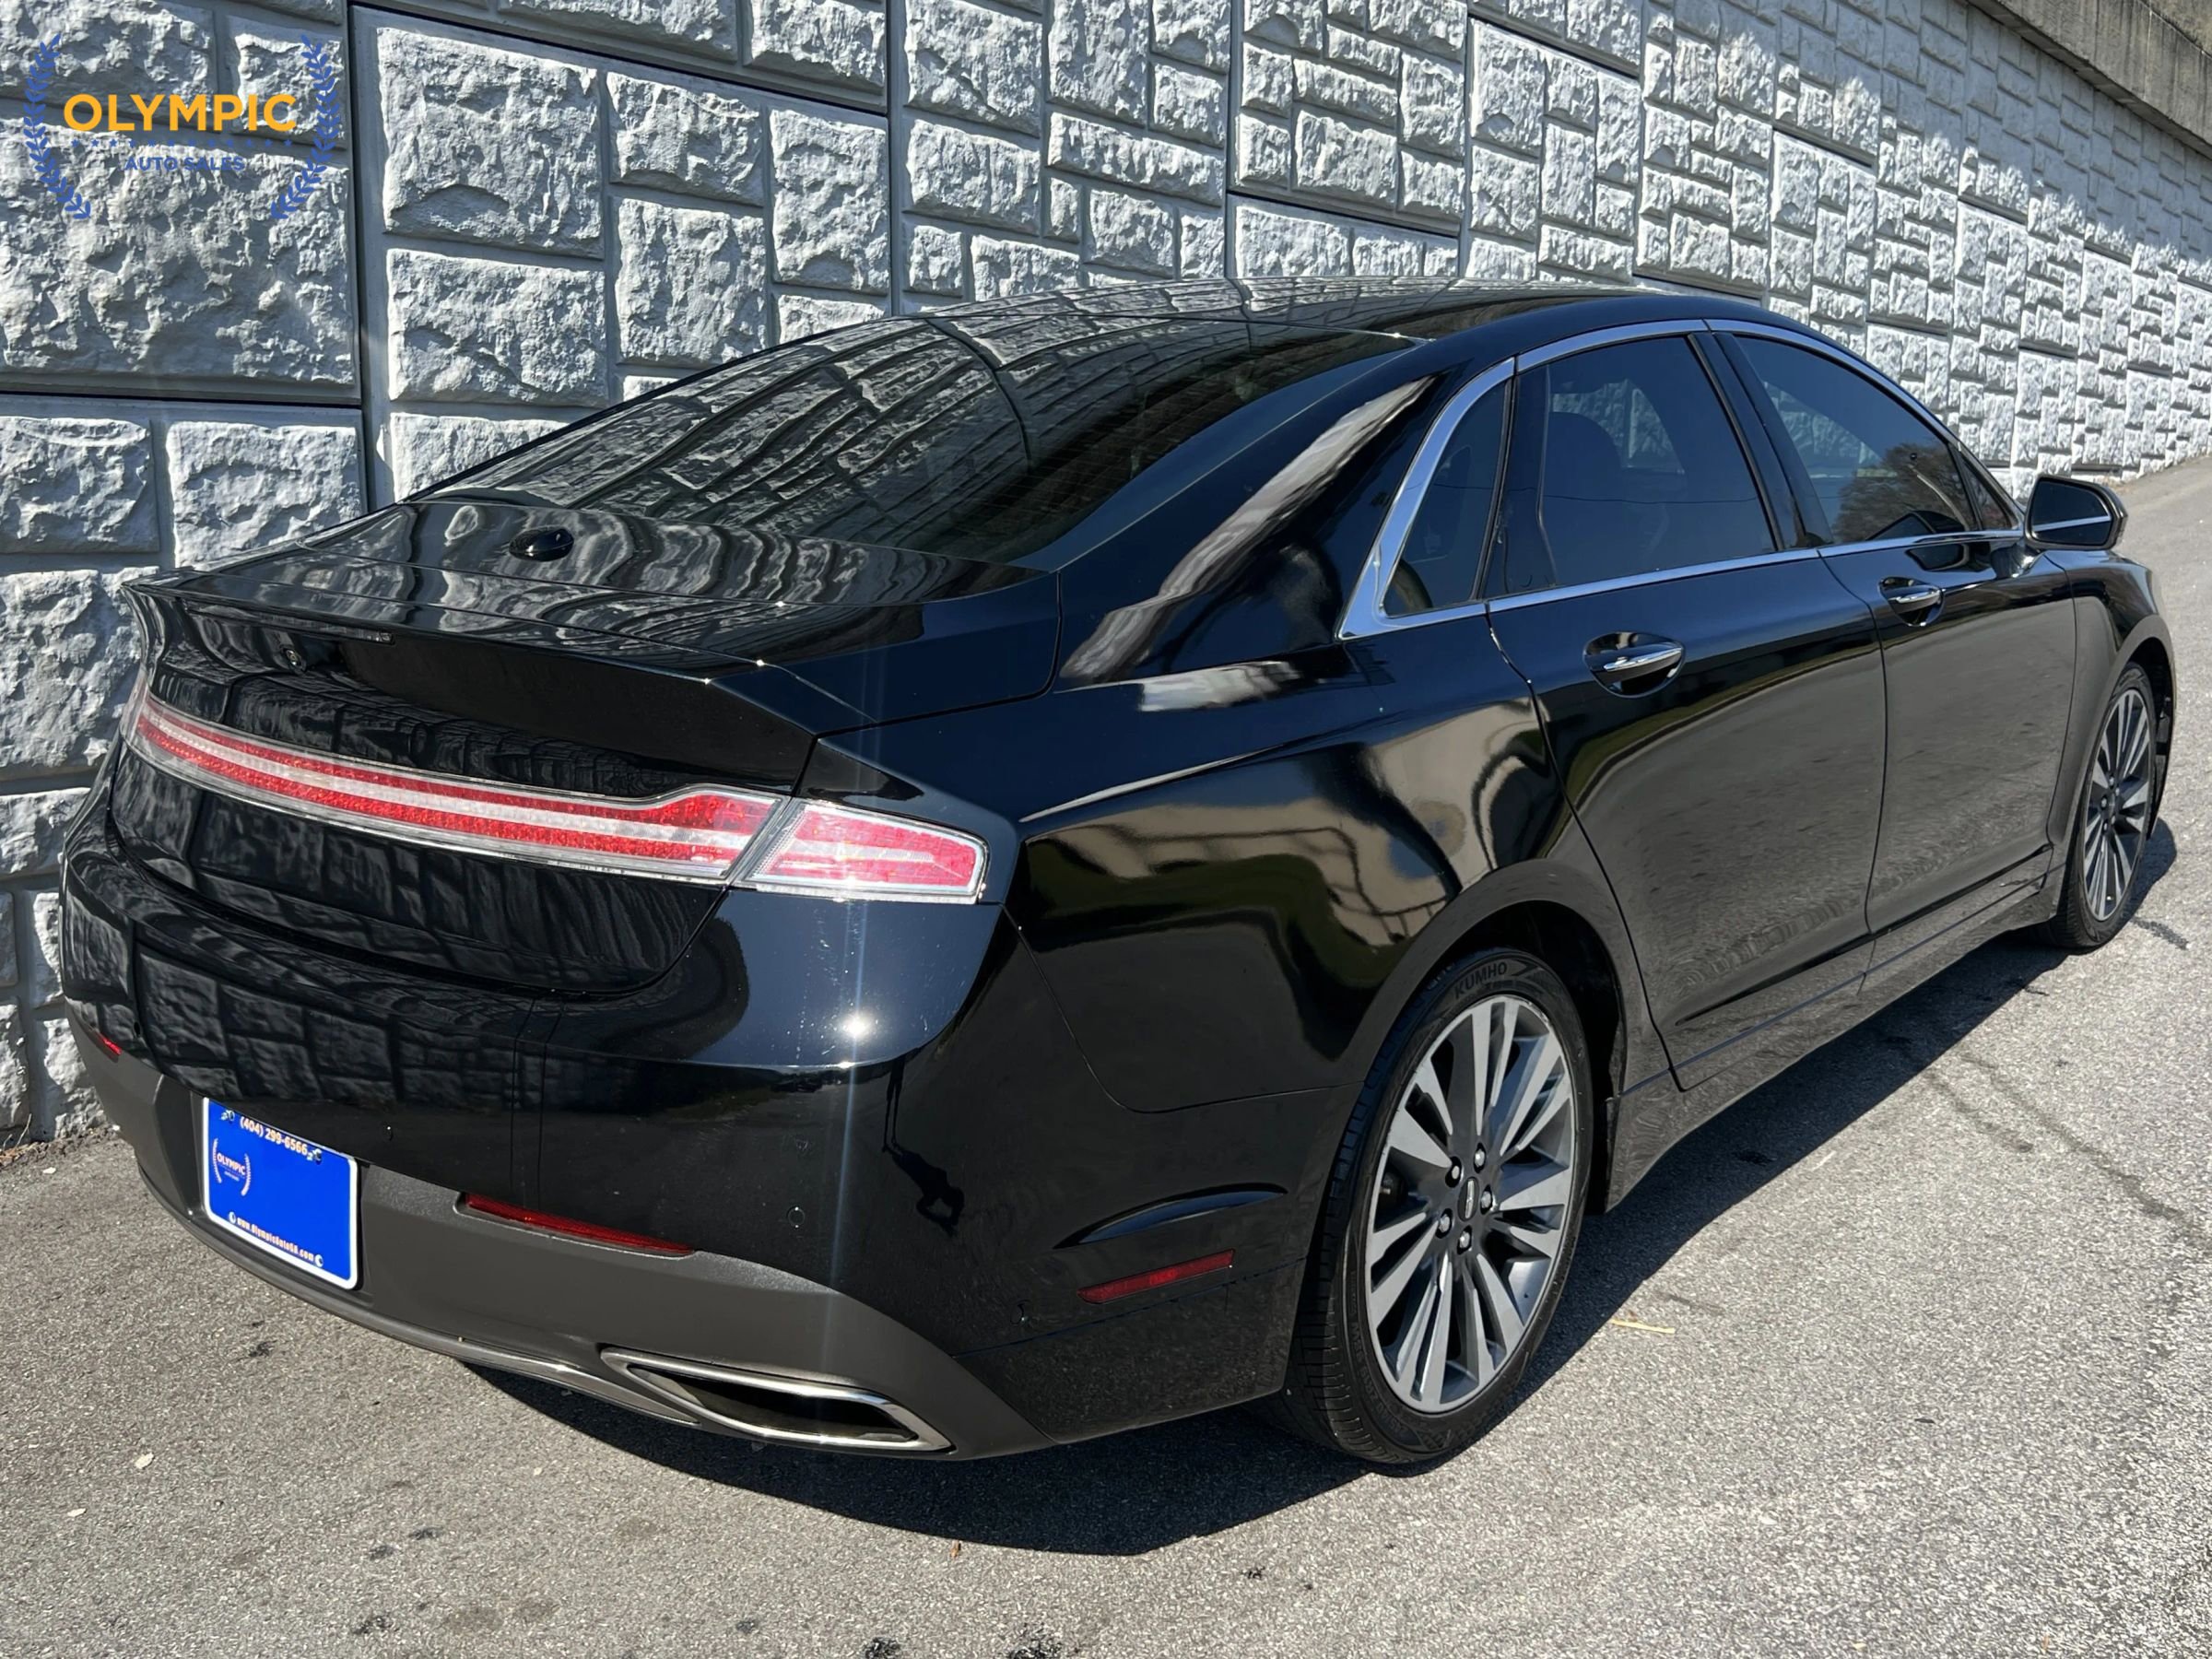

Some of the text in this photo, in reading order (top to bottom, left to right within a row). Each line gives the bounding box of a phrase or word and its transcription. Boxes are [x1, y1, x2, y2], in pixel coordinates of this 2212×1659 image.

[1454, 961, 1508, 999] KUMHO
[240, 1116, 308, 1157] (404) 299-6566
[217, 1152, 246, 1176] OLYMPIC
